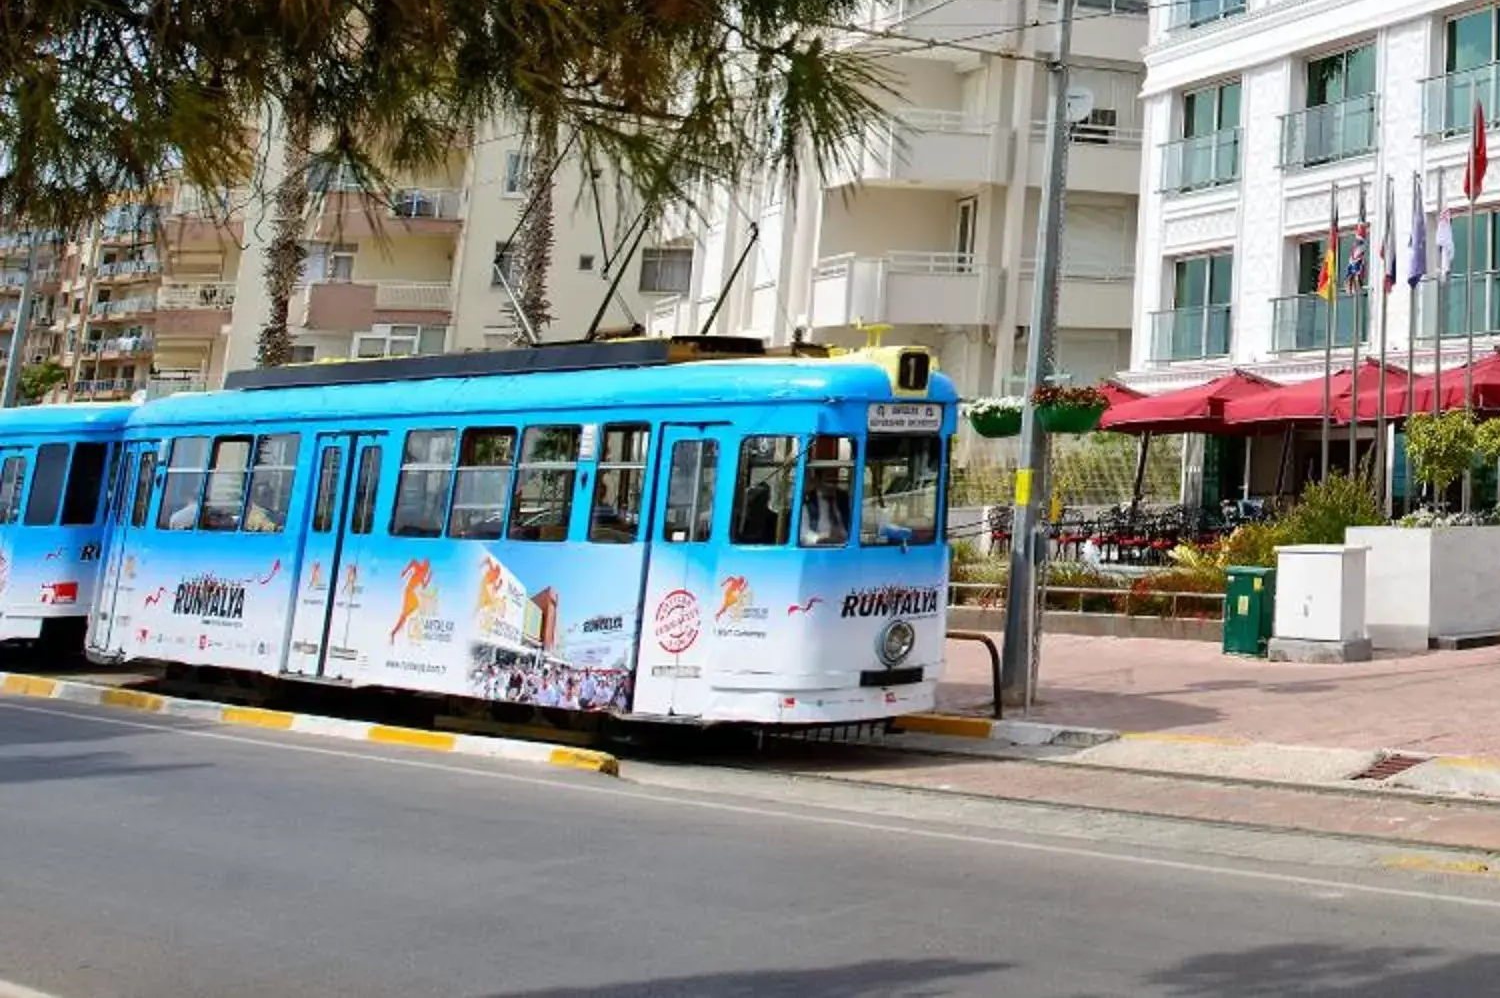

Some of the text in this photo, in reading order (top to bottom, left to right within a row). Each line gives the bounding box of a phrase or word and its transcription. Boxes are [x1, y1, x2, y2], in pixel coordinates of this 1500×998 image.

[908, 357, 916, 387] 1
[173, 582, 246, 619] RUNTALYA
[841, 590, 939, 618] RUNTALYA
